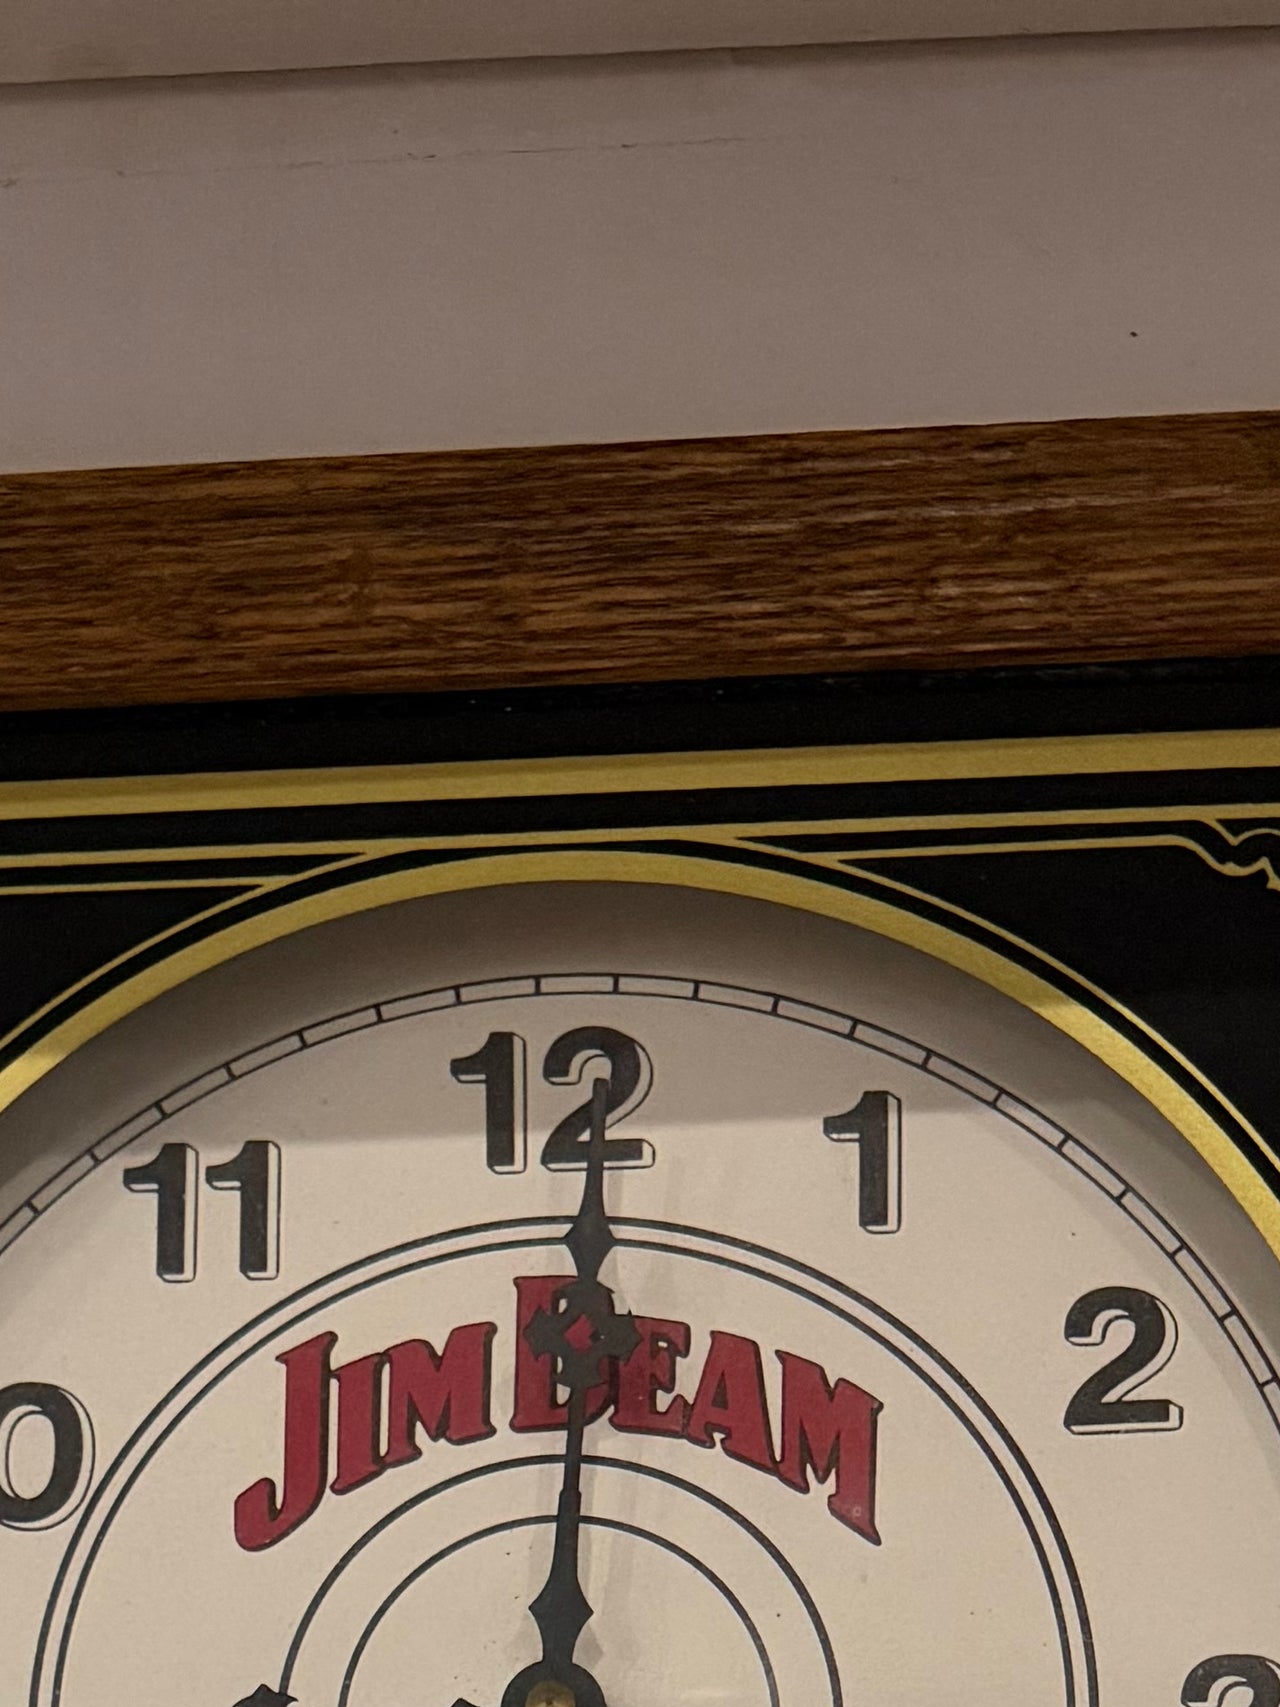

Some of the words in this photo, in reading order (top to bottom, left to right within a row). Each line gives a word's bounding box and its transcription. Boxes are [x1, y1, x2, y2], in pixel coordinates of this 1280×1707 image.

[450, 1026, 654, 1173] 12
[822, 1090, 902, 1233] 1
[123, 1140, 281, 1283] 11
[1063, 1286, 1183, 1435] 2
[234, 1322, 497, 1552] JIM
